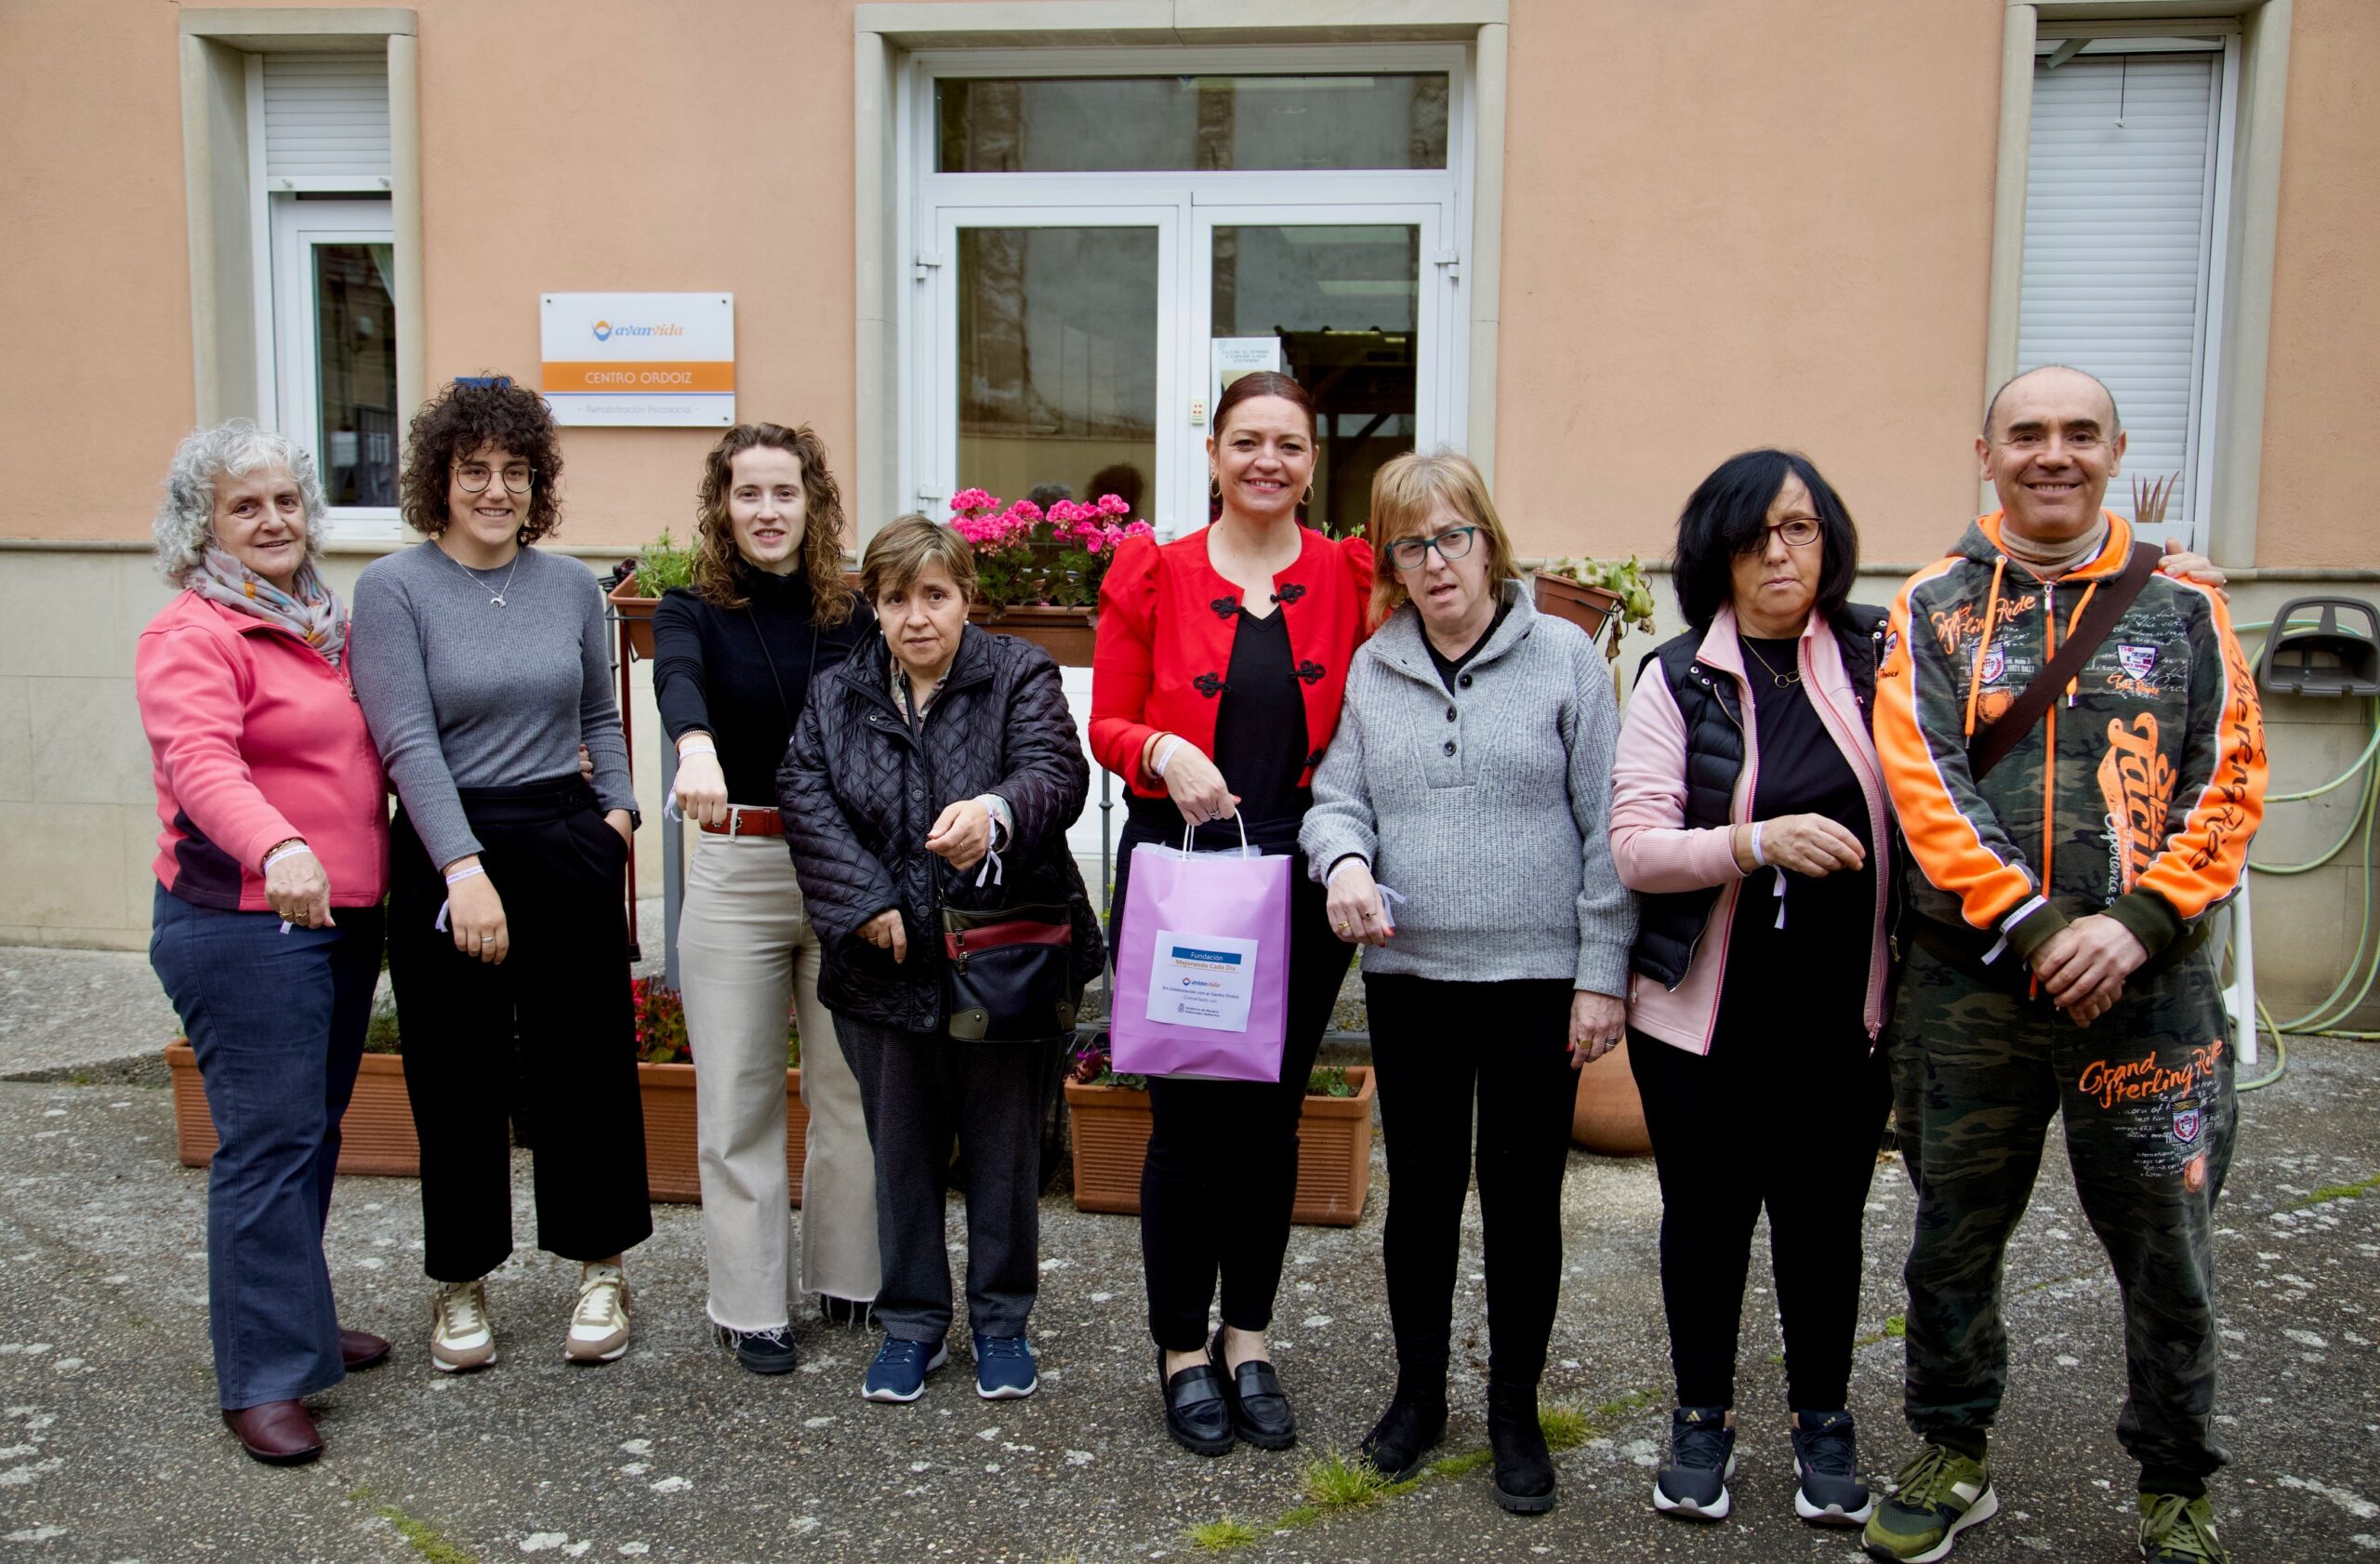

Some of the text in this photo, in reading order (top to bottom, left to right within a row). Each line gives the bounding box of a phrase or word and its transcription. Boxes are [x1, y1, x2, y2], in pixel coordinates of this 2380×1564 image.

[615, 323, 684, 337] avanvida
[585, 372, 693, 384] CENTRO ORDOIZ
[586, 404, 692, 414] Rehabilitación Psicosocial
[1996, 595, 2036, 623] Ride
[1190, 951, 1223, 961] Fundación
[1175, 959, 1209, 969] Mejorando
[2079, 1051, 2156, 1095] Grand
[2100, 1063, 2194, 1109] Sterling
